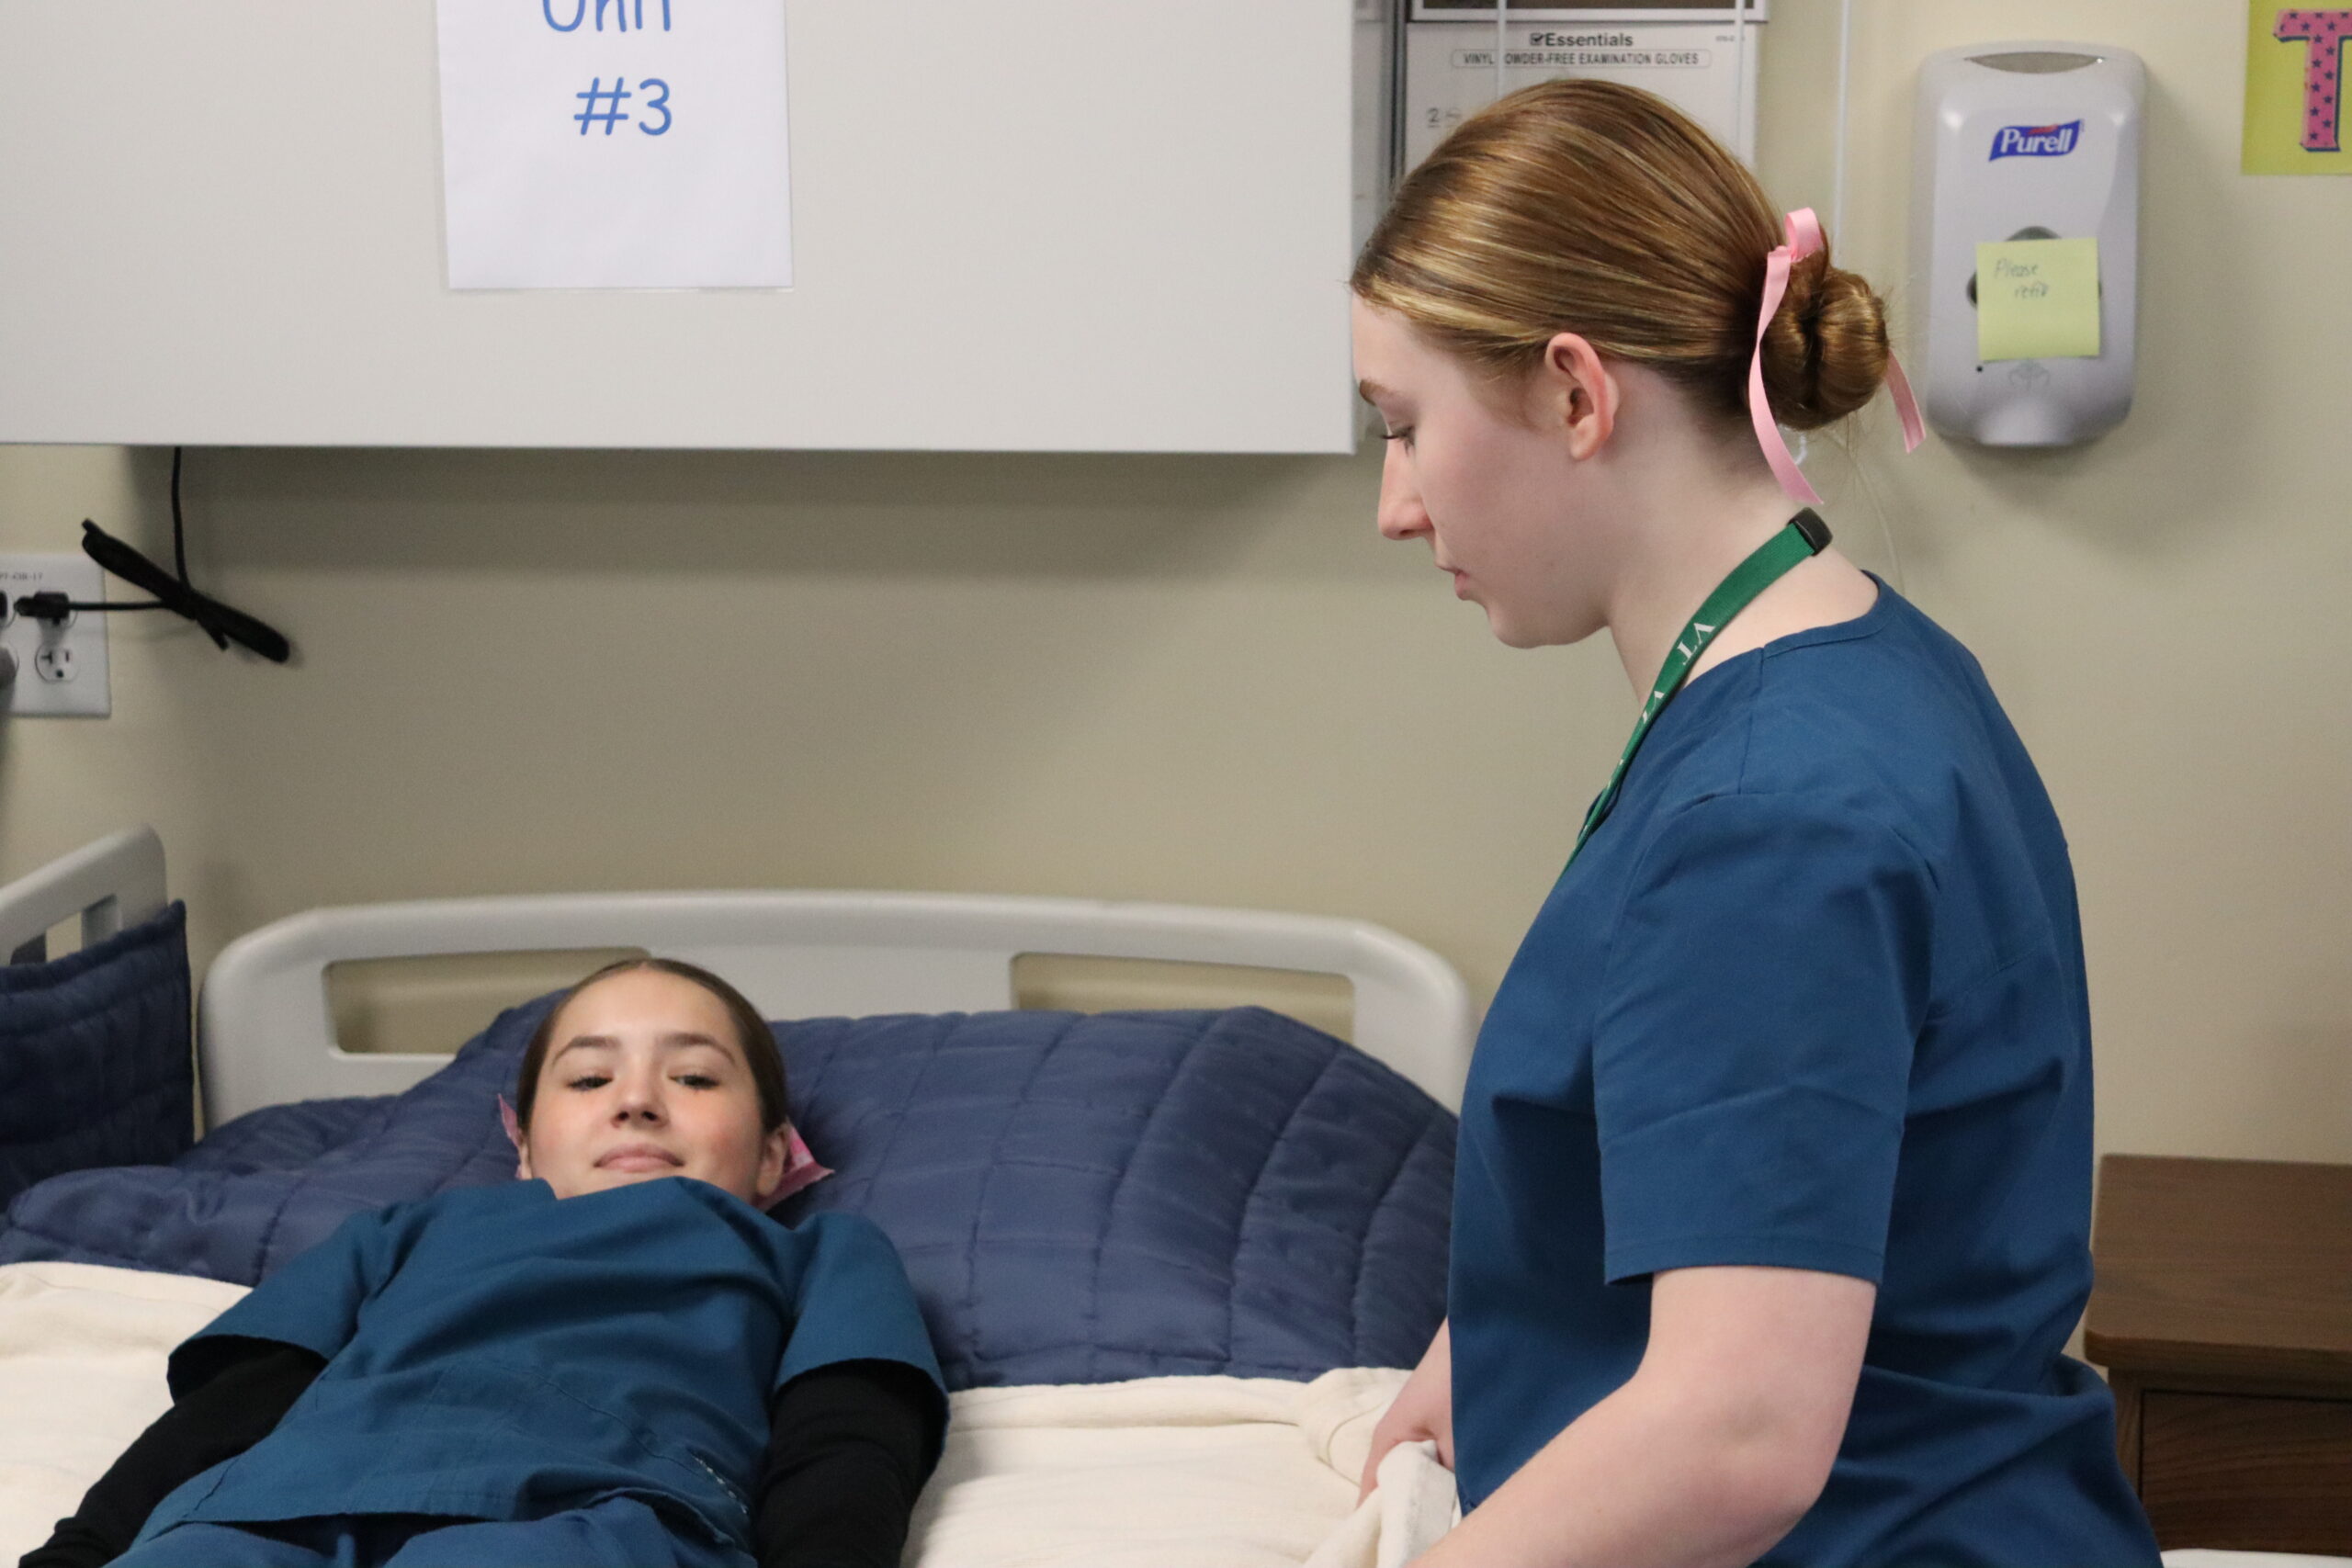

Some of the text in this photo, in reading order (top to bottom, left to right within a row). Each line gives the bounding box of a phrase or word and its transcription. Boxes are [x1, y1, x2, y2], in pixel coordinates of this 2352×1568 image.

[1545, 32, 1634, 47] Essentials
[1464, 51, 1700, 65] VINYL OWDER-FREE EXAMINATION GLOVES
[2273, 9, 2352, 152] T
[573, 77, 673, 136] #3
[2000, 128, 2073, 153] Purell
